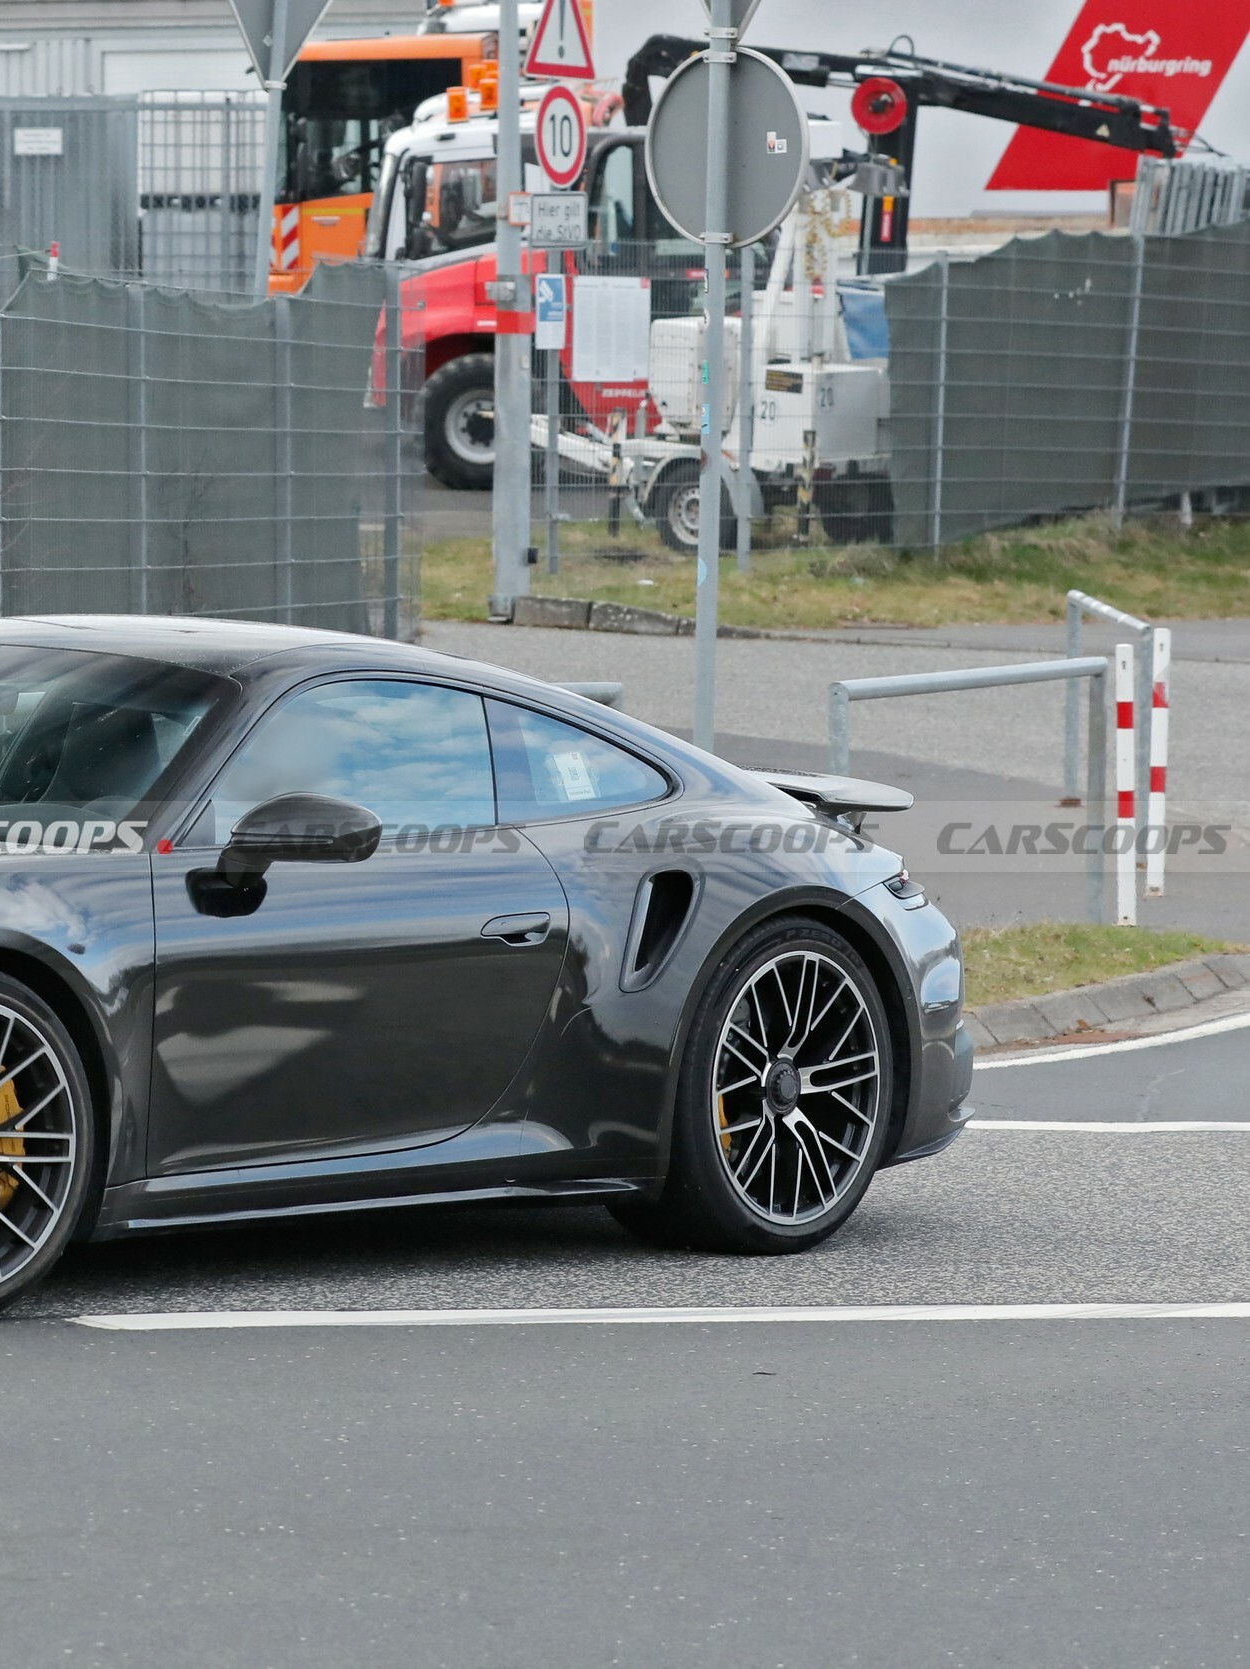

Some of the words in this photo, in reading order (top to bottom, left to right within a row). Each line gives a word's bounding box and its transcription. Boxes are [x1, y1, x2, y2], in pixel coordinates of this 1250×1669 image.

[1107, 56, 1211, 76] nürburgring
[550, 114, 572, 156] 10
[538, 202, 560, 217] Hier
[565, 202, 580, 221] gilt
[761, 400, 776, 420] 20
